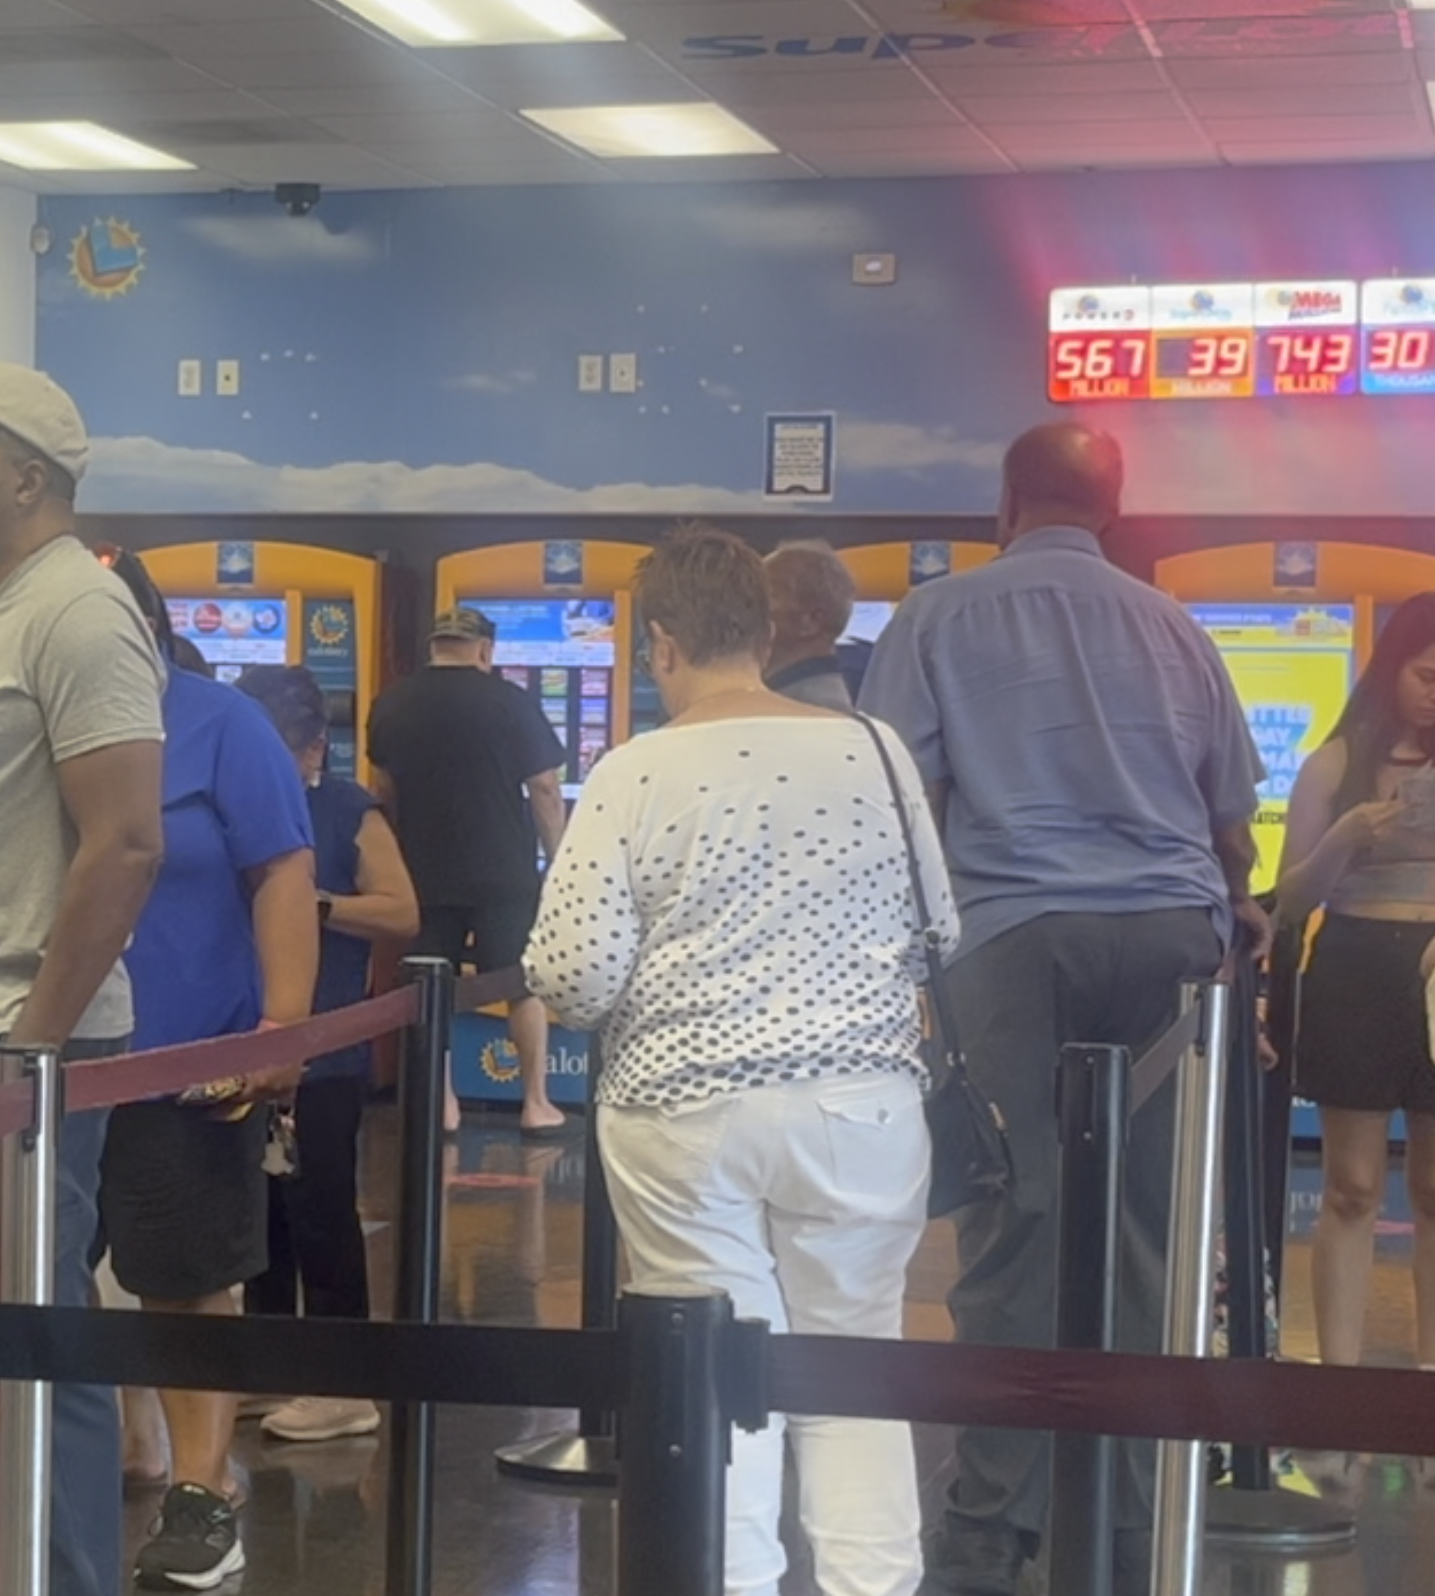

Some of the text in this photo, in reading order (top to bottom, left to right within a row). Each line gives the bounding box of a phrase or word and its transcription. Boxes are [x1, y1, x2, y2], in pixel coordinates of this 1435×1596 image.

[1056, 339, 1146, 380] 567
[1187, 337, 1247, 376] 39
[1267, 334, 1352, 374] 743
